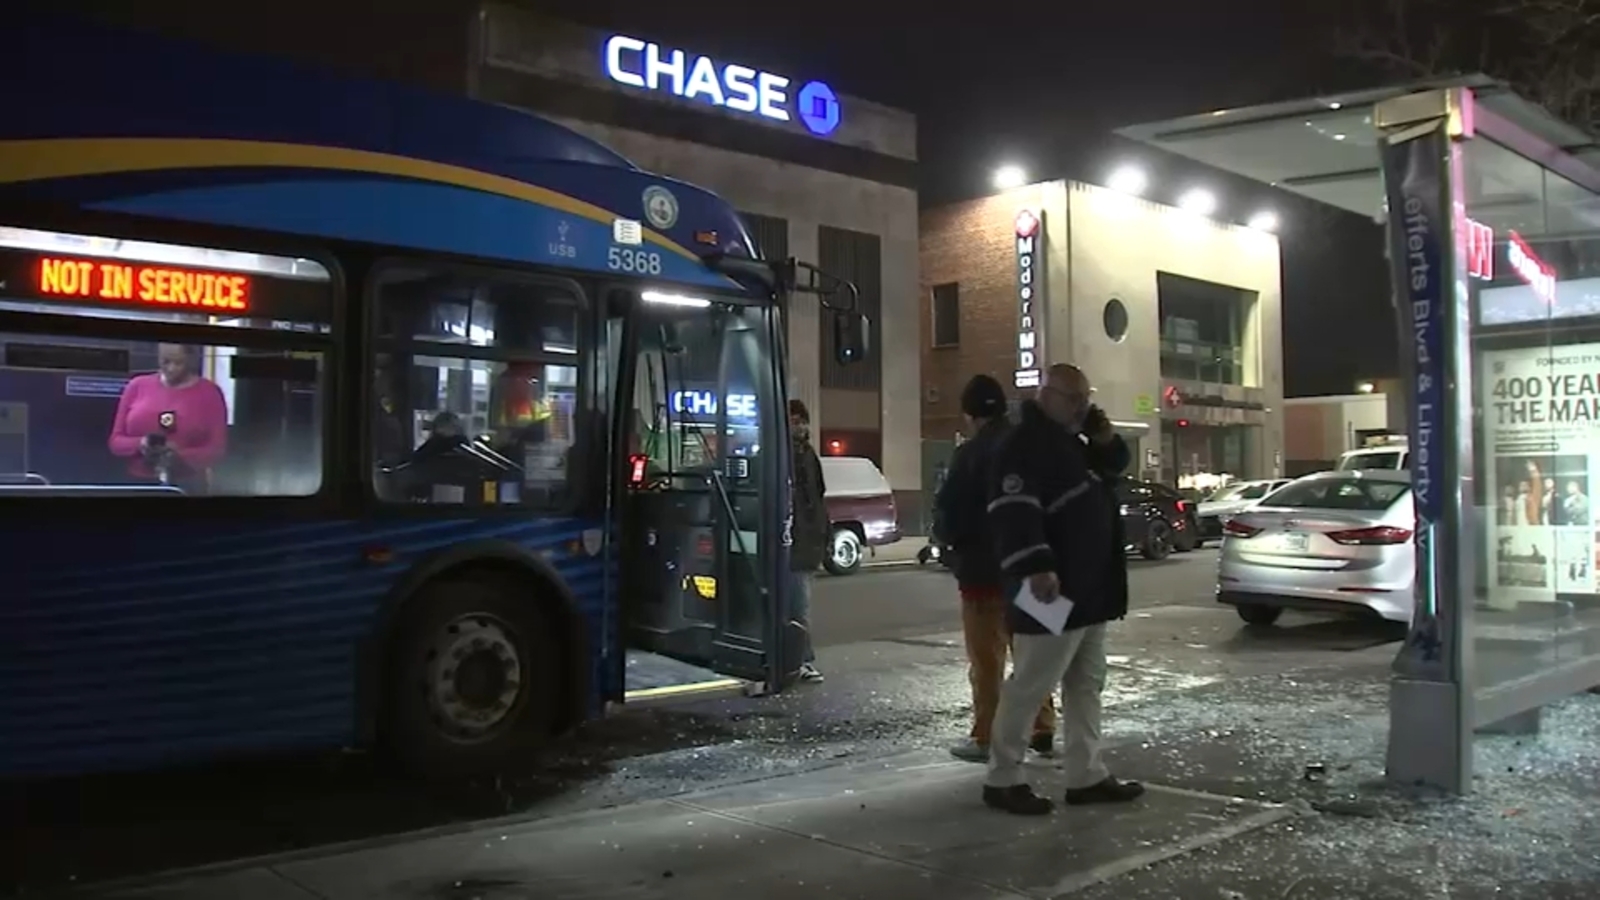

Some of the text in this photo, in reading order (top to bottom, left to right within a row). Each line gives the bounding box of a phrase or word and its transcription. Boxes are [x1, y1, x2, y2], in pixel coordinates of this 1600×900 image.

[607, 35, 790, 120] CHASE
[548, 242, 577, 257] USB
[607, 247, 662, 274] 5368
[1404, 197, 1430, 291] efferts
[41, 257, 246, 309] NOT IN SERVICE
[1413, 299, 1431, 363] Blvd
[1418, 373, 1433, 394] &
[1492, 373, 1600, 400] 400 YEA
[1493, 400, 1546, 424] THE
[1415, 404, 1433, 503] Liberty
